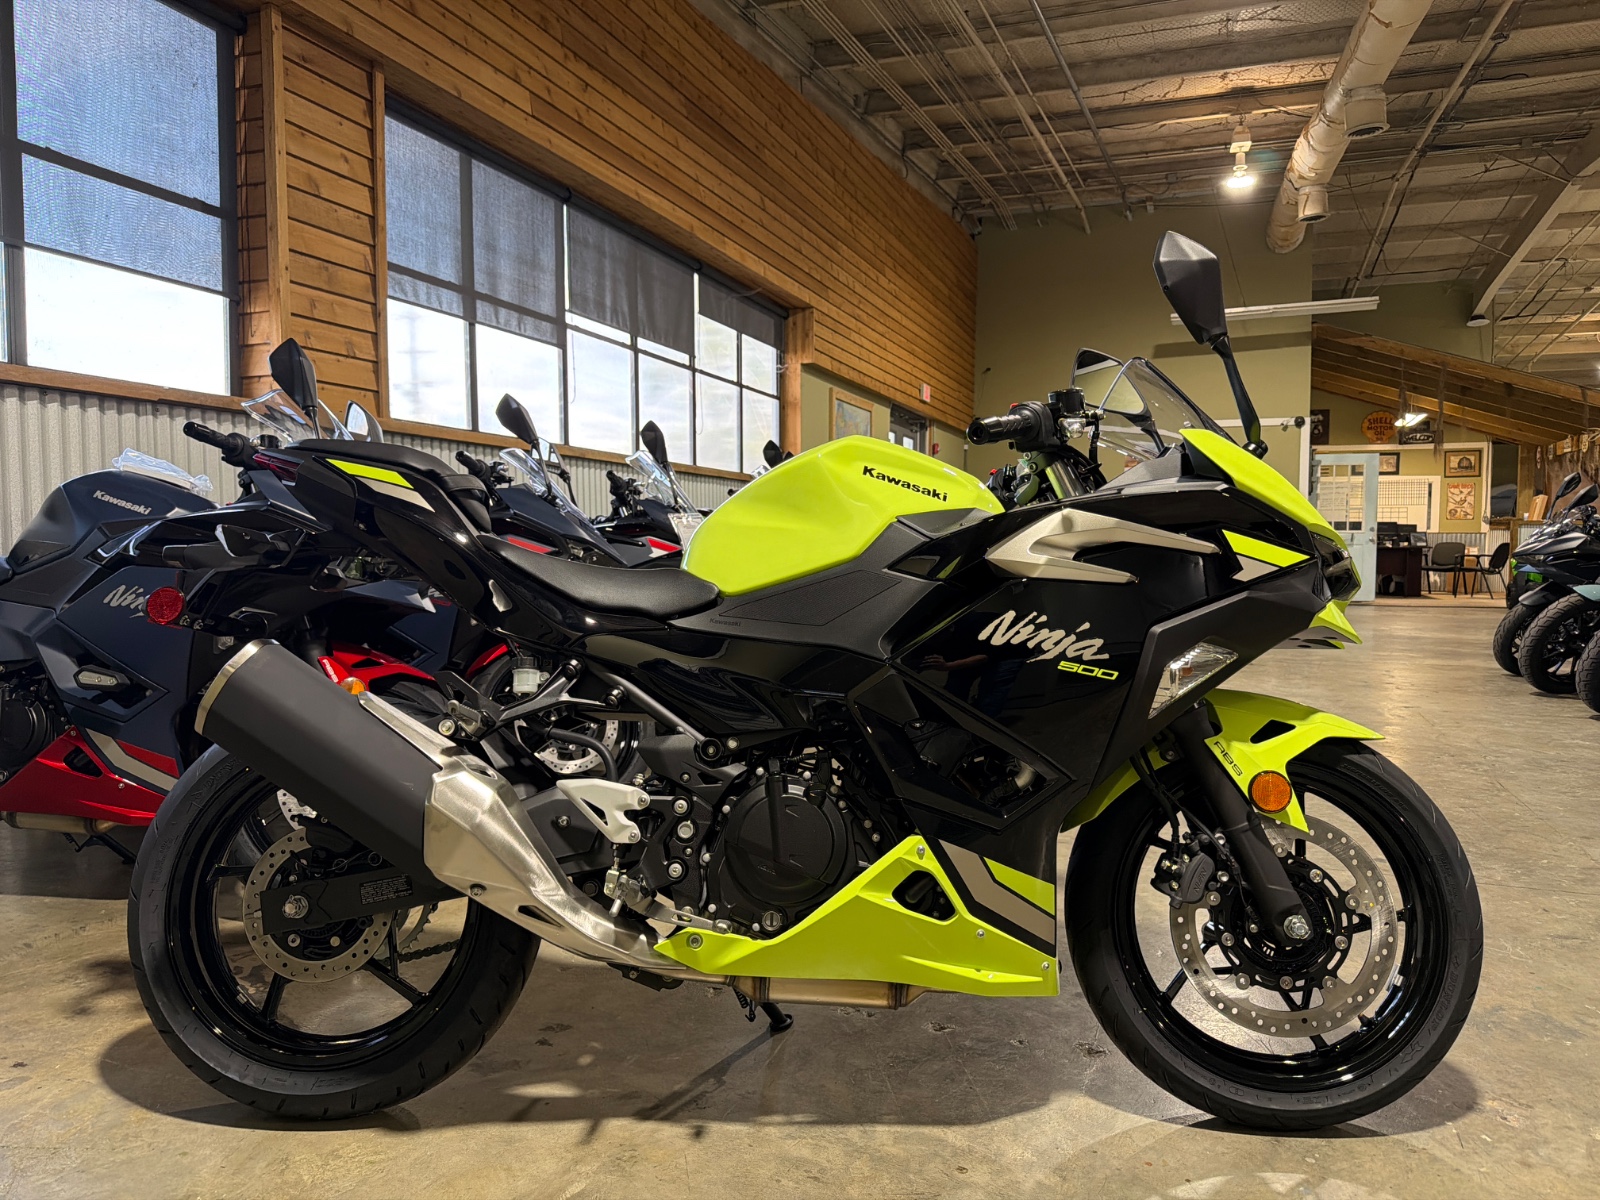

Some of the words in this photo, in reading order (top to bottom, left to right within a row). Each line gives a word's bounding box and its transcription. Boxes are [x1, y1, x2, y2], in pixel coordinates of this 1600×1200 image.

[1368, 416, 1394, 425] SHELL
[862, 465, 948, 502] Kawasaki
[93, 490, 152, 515] Kawasaki
[709, 618, 741, 627] Kawasaki
[978, 610, 1109, 663] Ninja
[1057, 661, 1119, 680] 500
[1213, 741, 1243, 777] ABS
